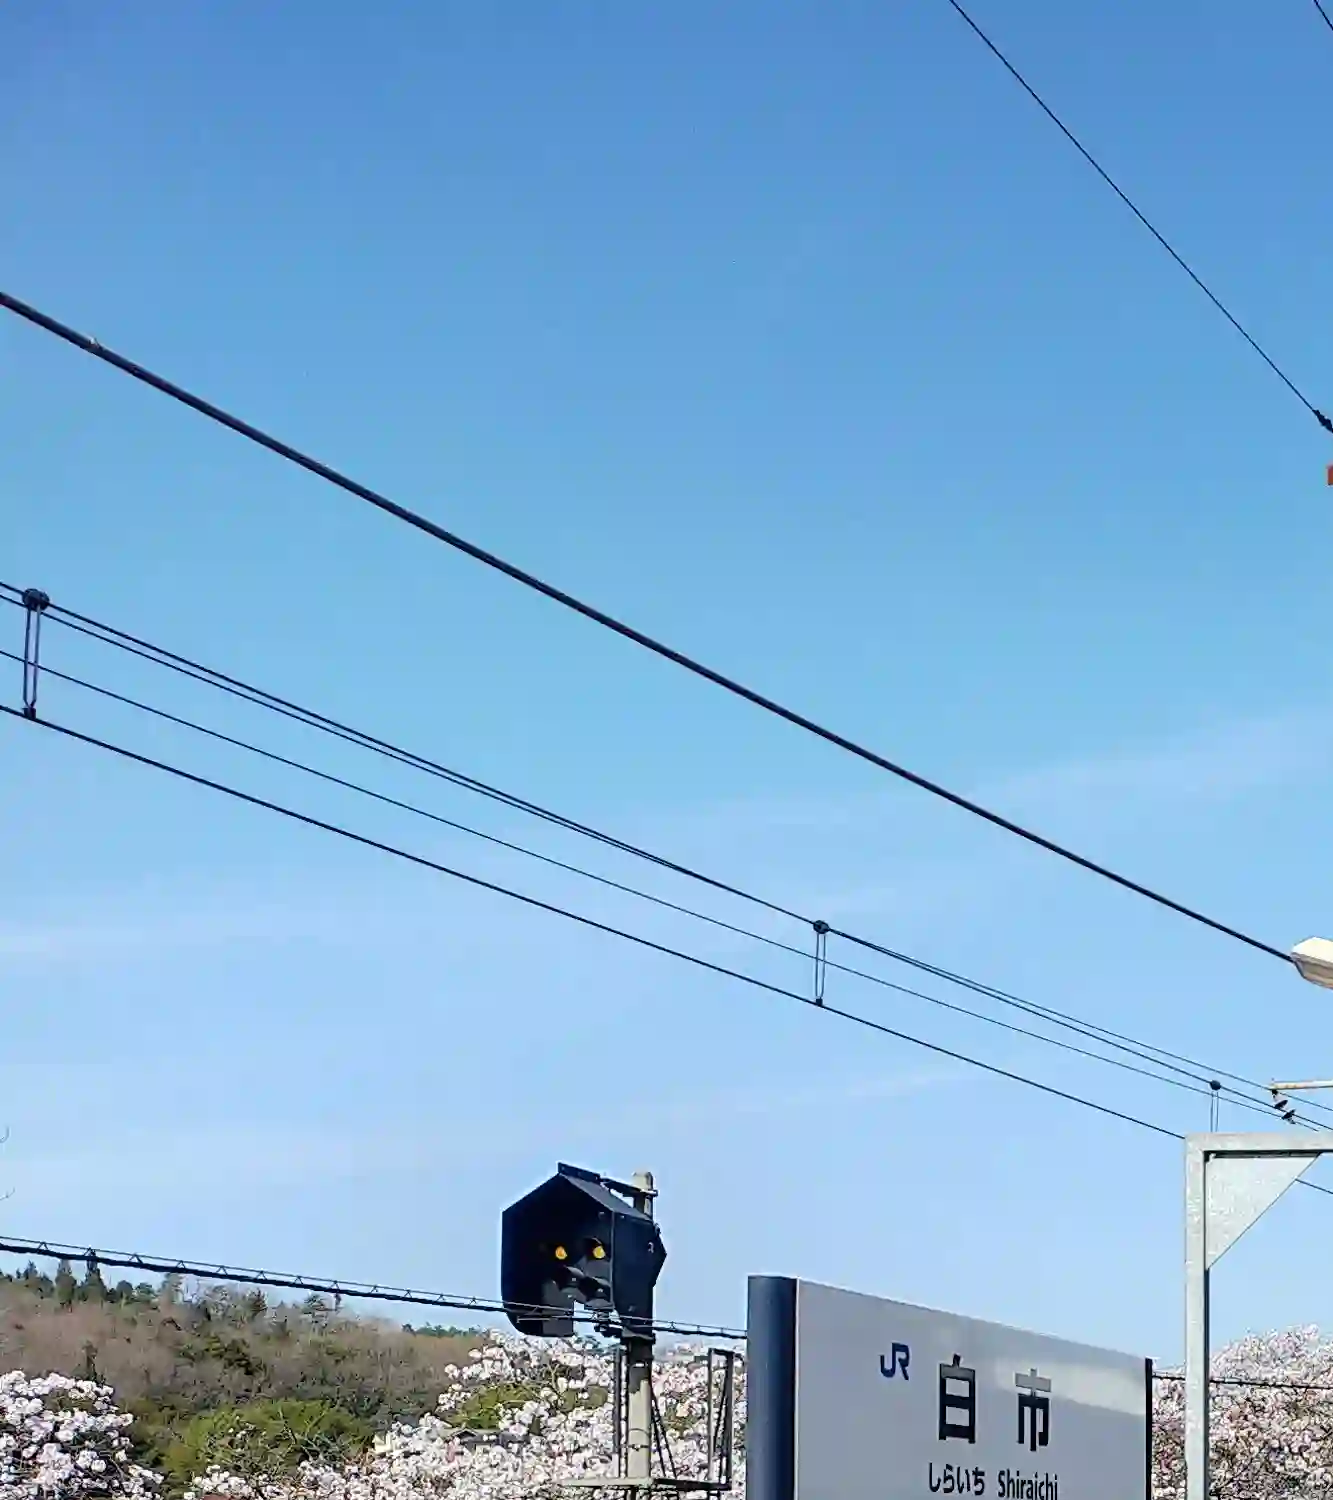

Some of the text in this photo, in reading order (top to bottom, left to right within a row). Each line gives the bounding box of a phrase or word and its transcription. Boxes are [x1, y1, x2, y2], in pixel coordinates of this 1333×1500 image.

[879, 1342, 910, 1380] JR
[938, 1353, 1052, 1452] 白市
[928, 1462, 986, 1496] しらいち
